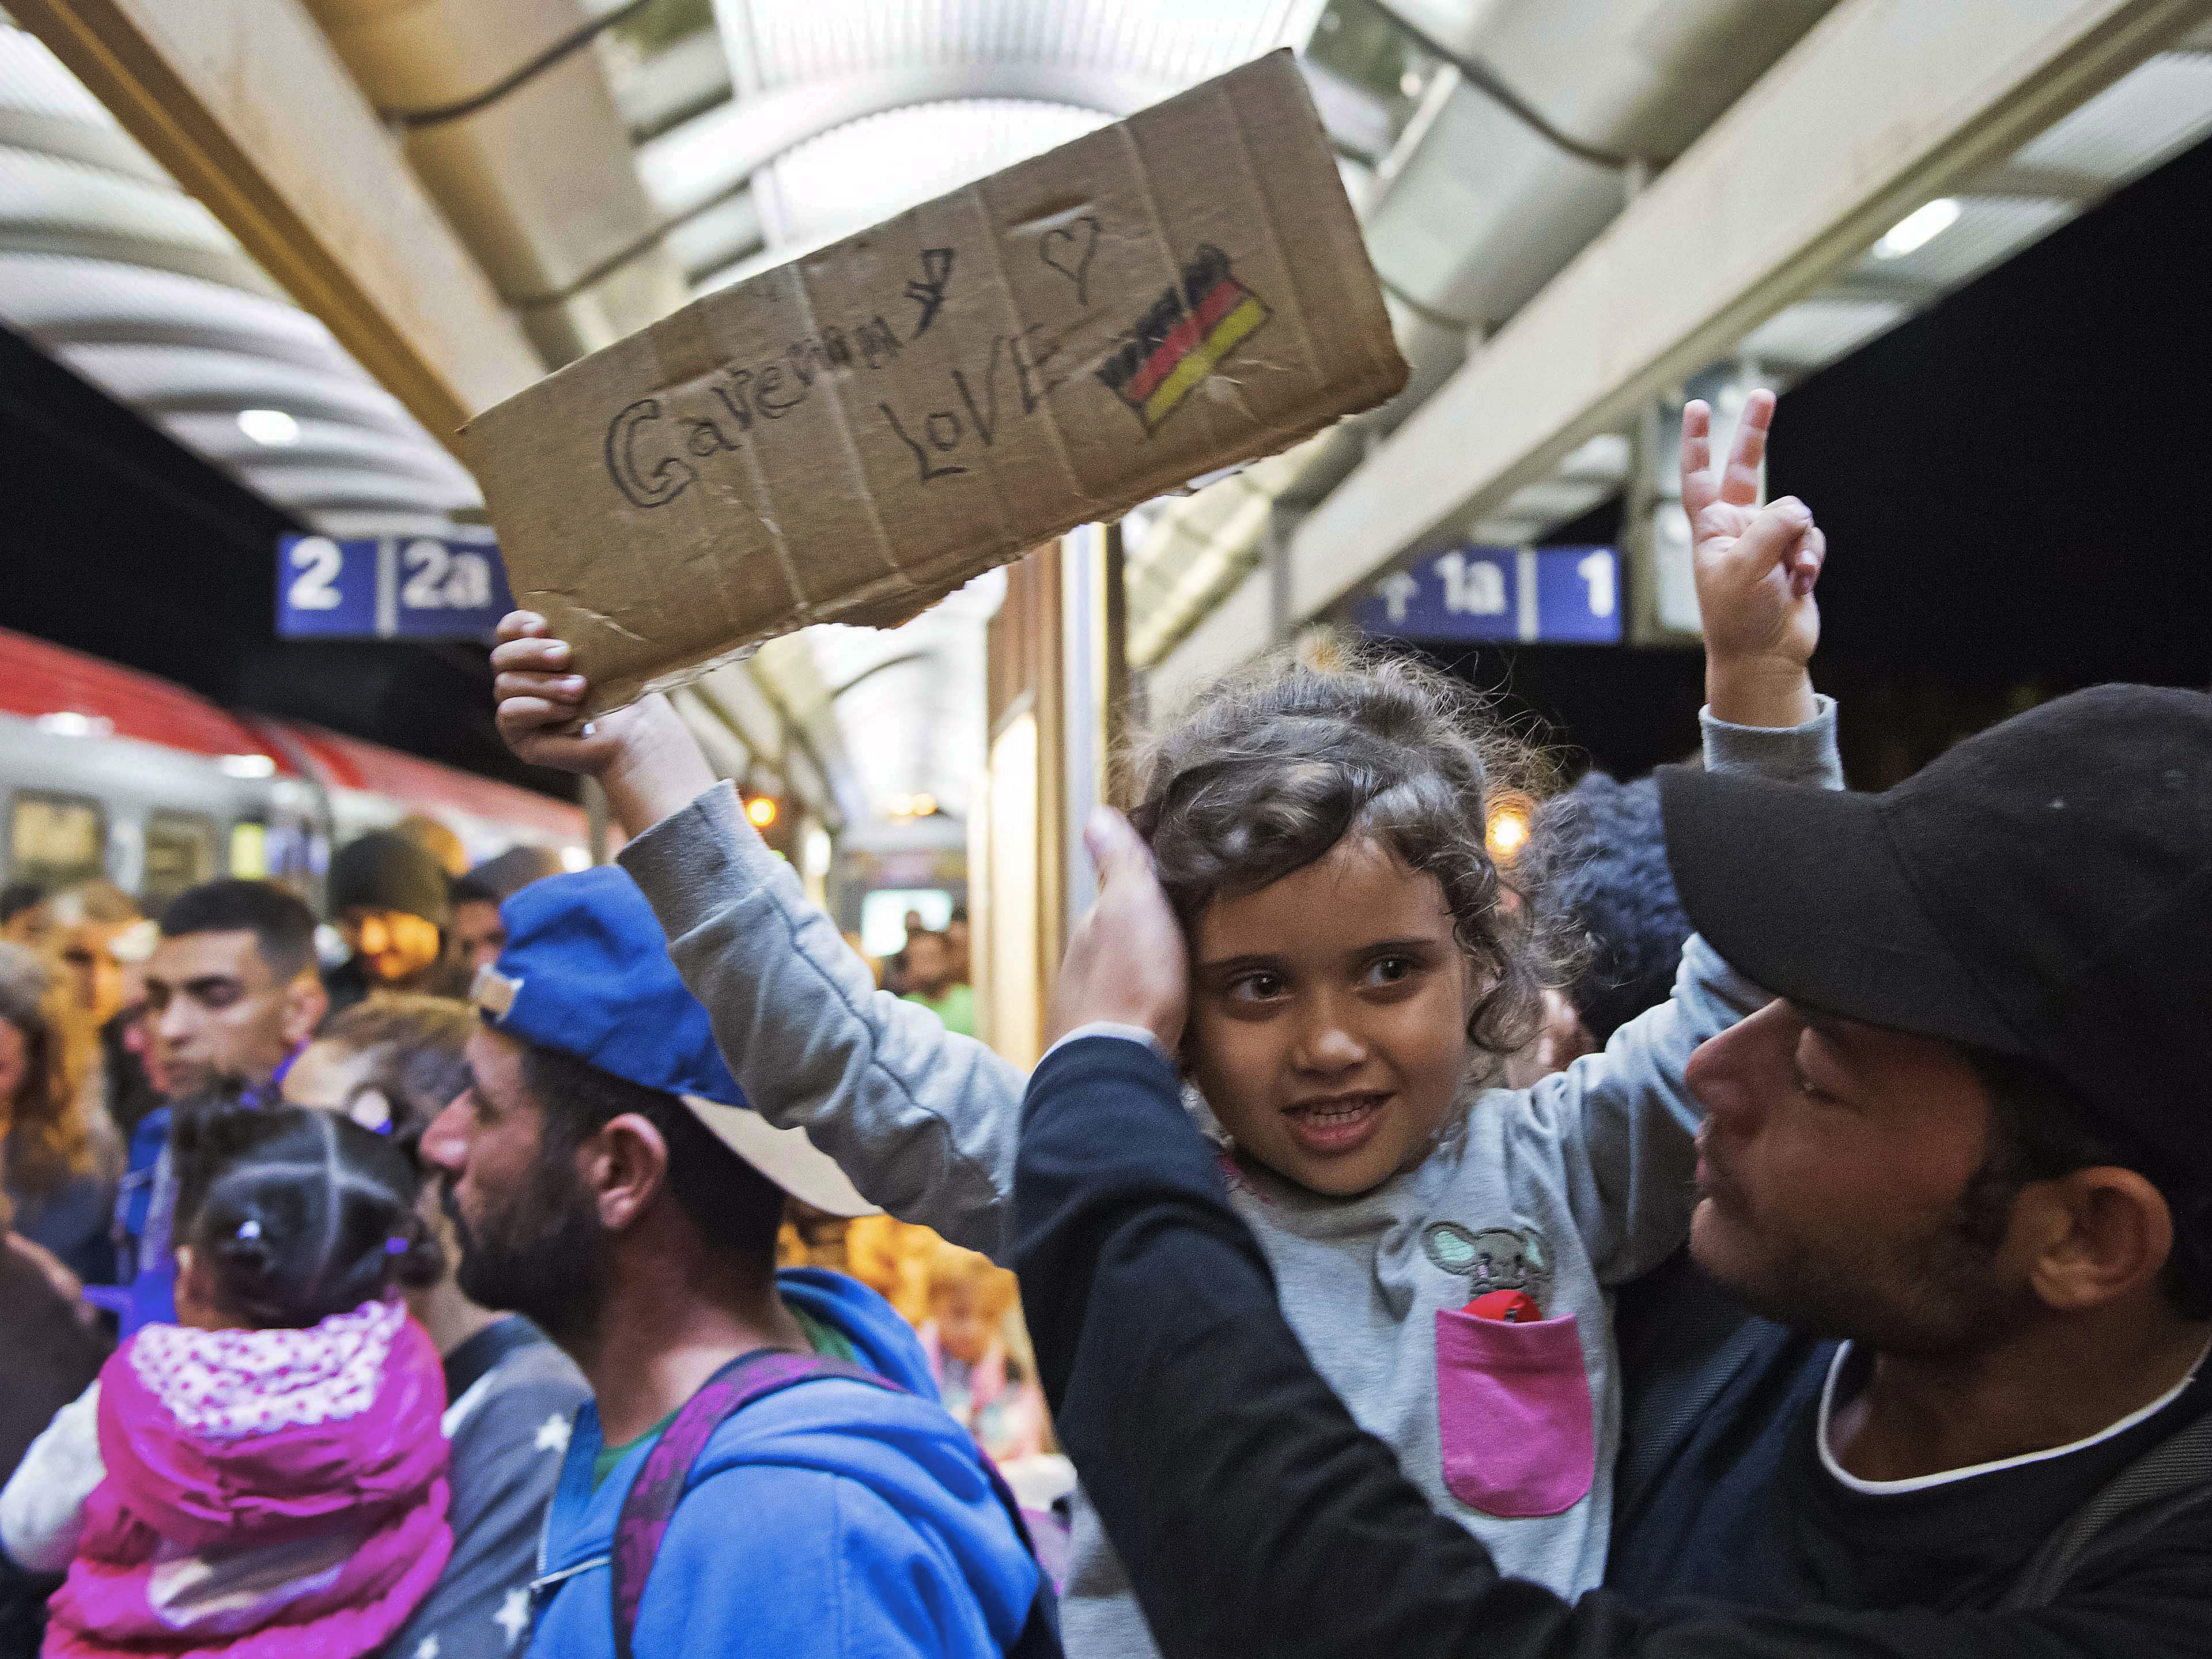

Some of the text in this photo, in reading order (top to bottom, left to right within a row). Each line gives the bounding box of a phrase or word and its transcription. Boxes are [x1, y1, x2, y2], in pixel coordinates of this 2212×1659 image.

[289, 536, 491, 611] 2 2a
[1437, 549, 1614, 618] 1a 1
